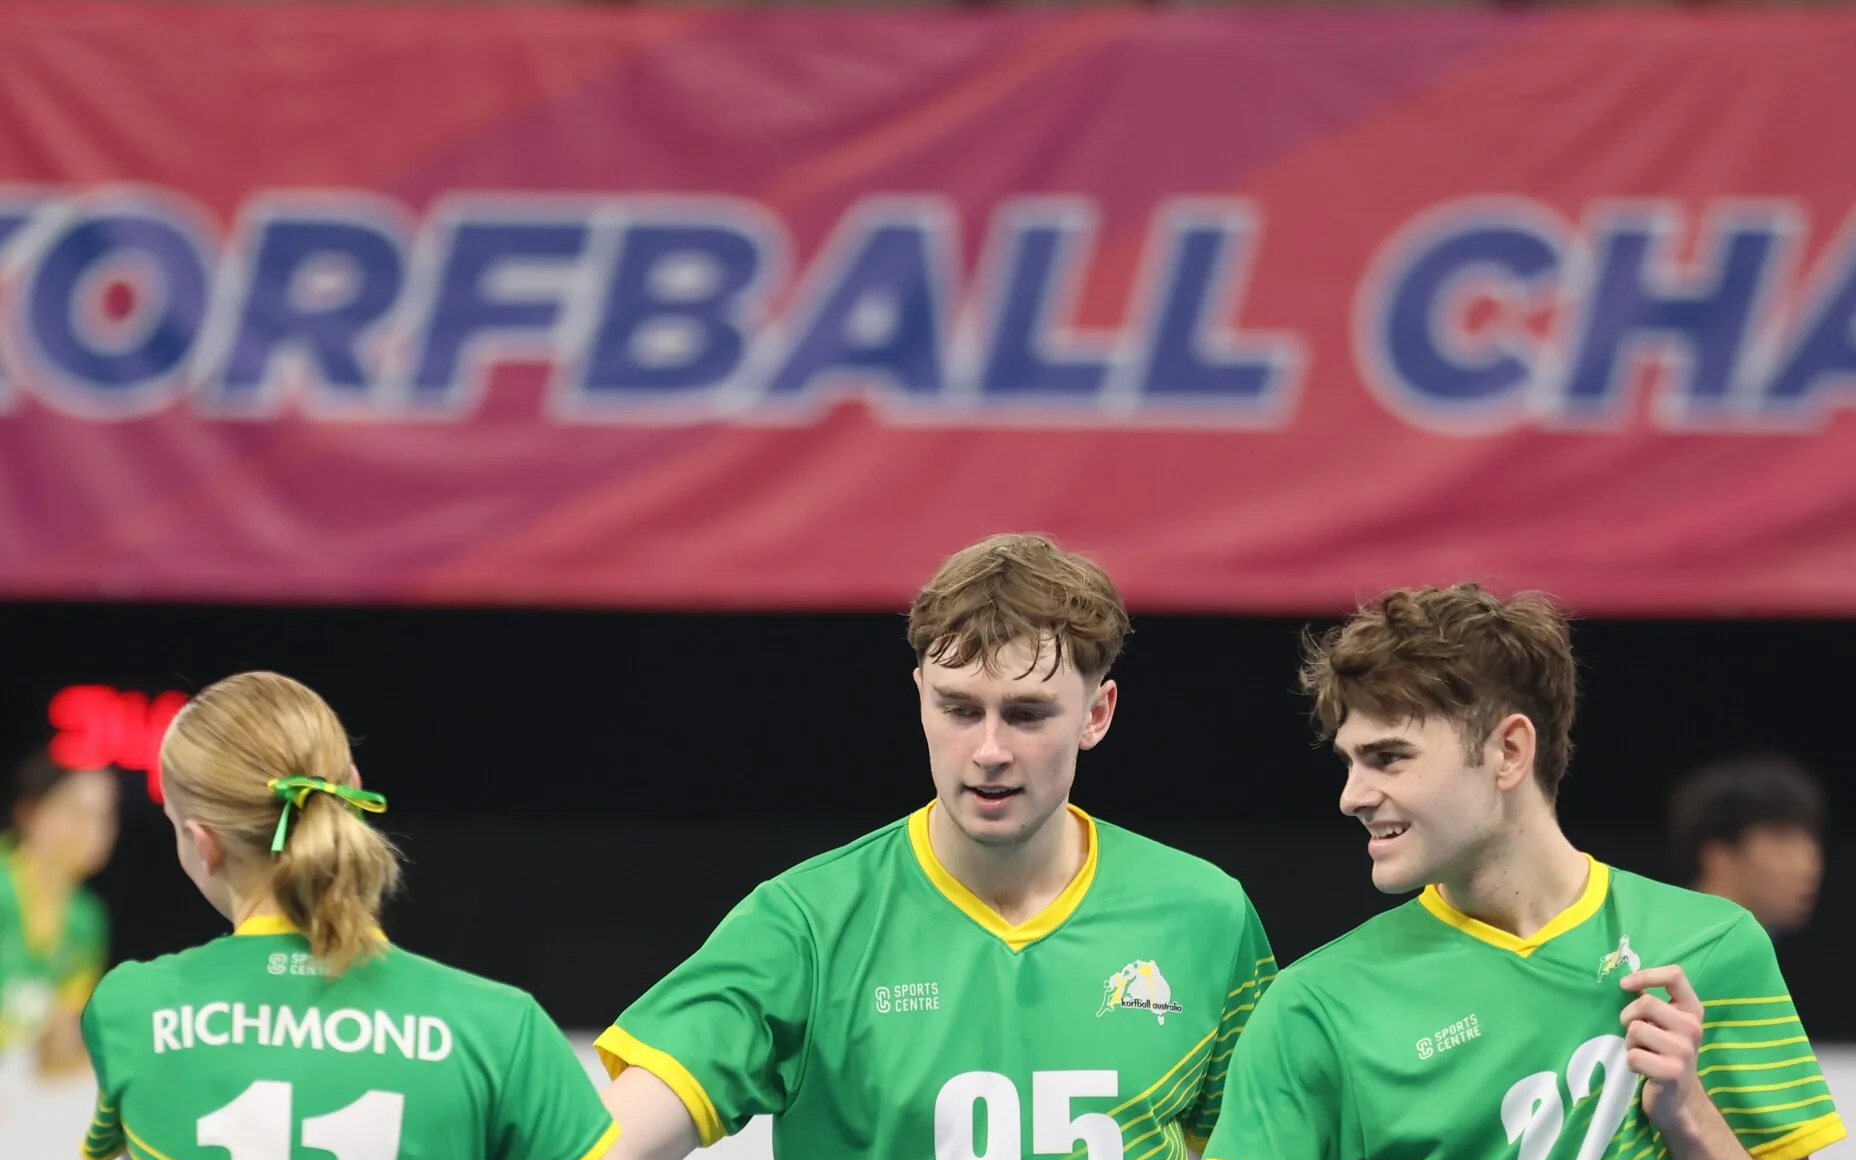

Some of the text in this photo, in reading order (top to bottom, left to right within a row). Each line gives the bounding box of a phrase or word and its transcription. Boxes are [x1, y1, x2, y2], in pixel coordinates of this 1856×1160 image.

[0, 188, 1304, 428] ORFBALL
[894, 982, 939, 998] SPORTS
[895, 997, 940, 1012] CENTRE
[1121, 997, 1182, 1012] korfball australia
[153, 1002, 453, 1061] RICHMOND
[1434, 1013, 1478, 1042] SPORTS
[1437, 1025, 1481, 1053] CENTRE
